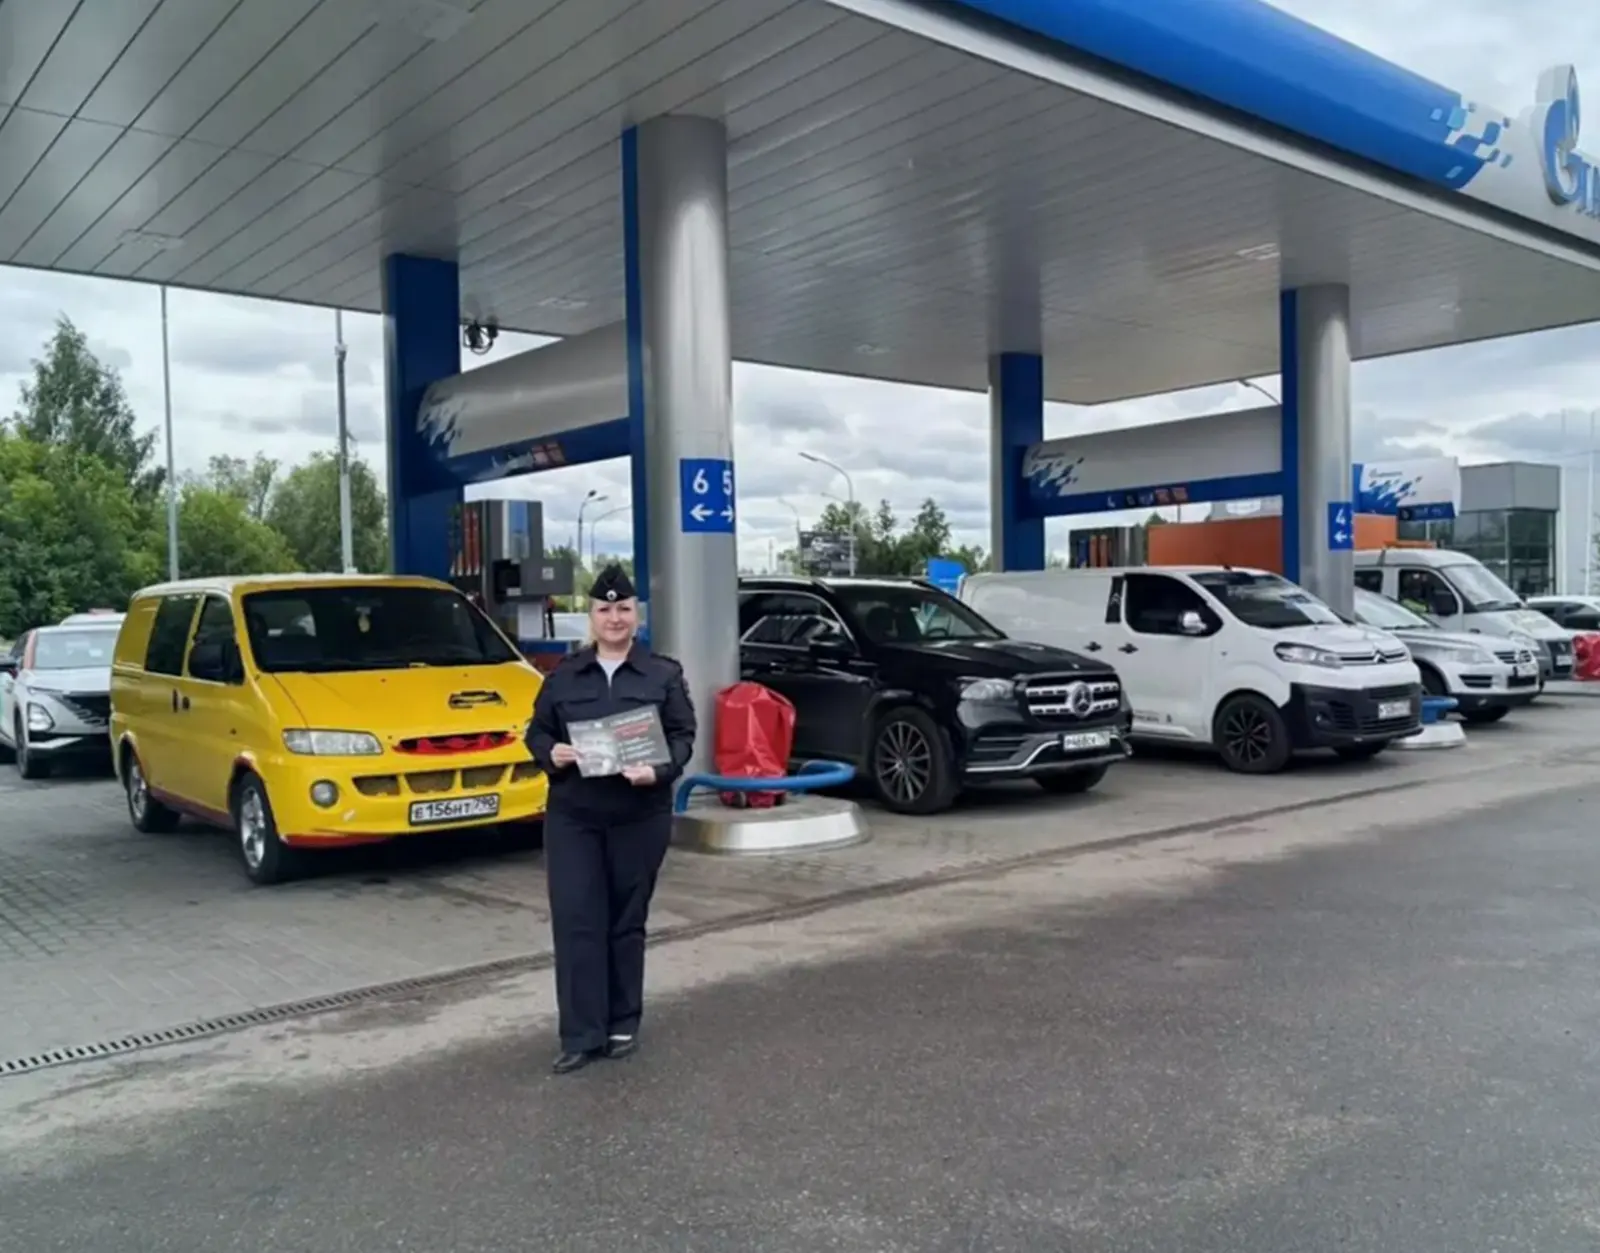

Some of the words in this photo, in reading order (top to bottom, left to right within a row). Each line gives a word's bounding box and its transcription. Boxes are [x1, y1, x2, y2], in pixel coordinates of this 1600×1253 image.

[692, 468, 709, 495] 6
[722, 469, 733, 496] 5
[1335, 508, 1346, 525] 4
